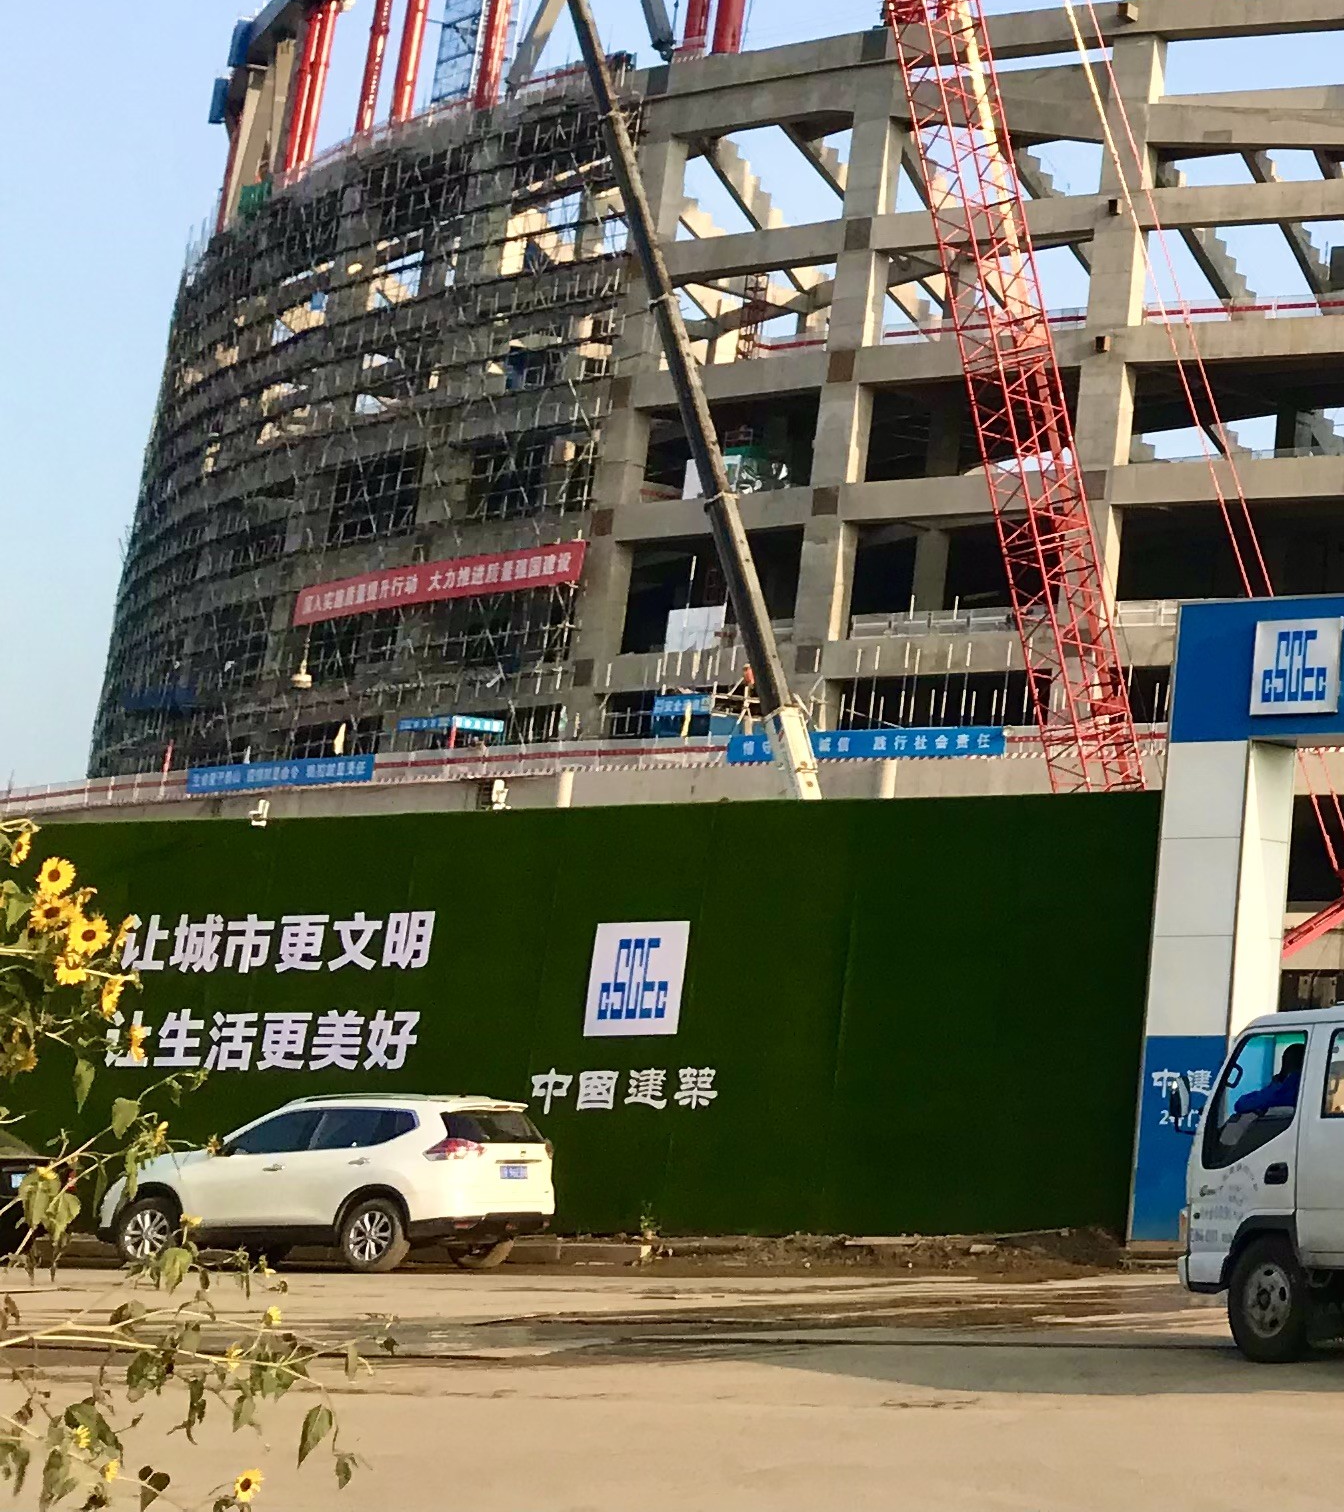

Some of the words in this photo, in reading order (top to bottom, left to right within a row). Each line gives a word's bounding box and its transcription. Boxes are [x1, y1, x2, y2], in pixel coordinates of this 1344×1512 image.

[121, 911, 436, 974] 让城市更文明
[104, 1008, 421, 1071] 让生活更美好
[531, 1067, 718, 1115] 中國建築
